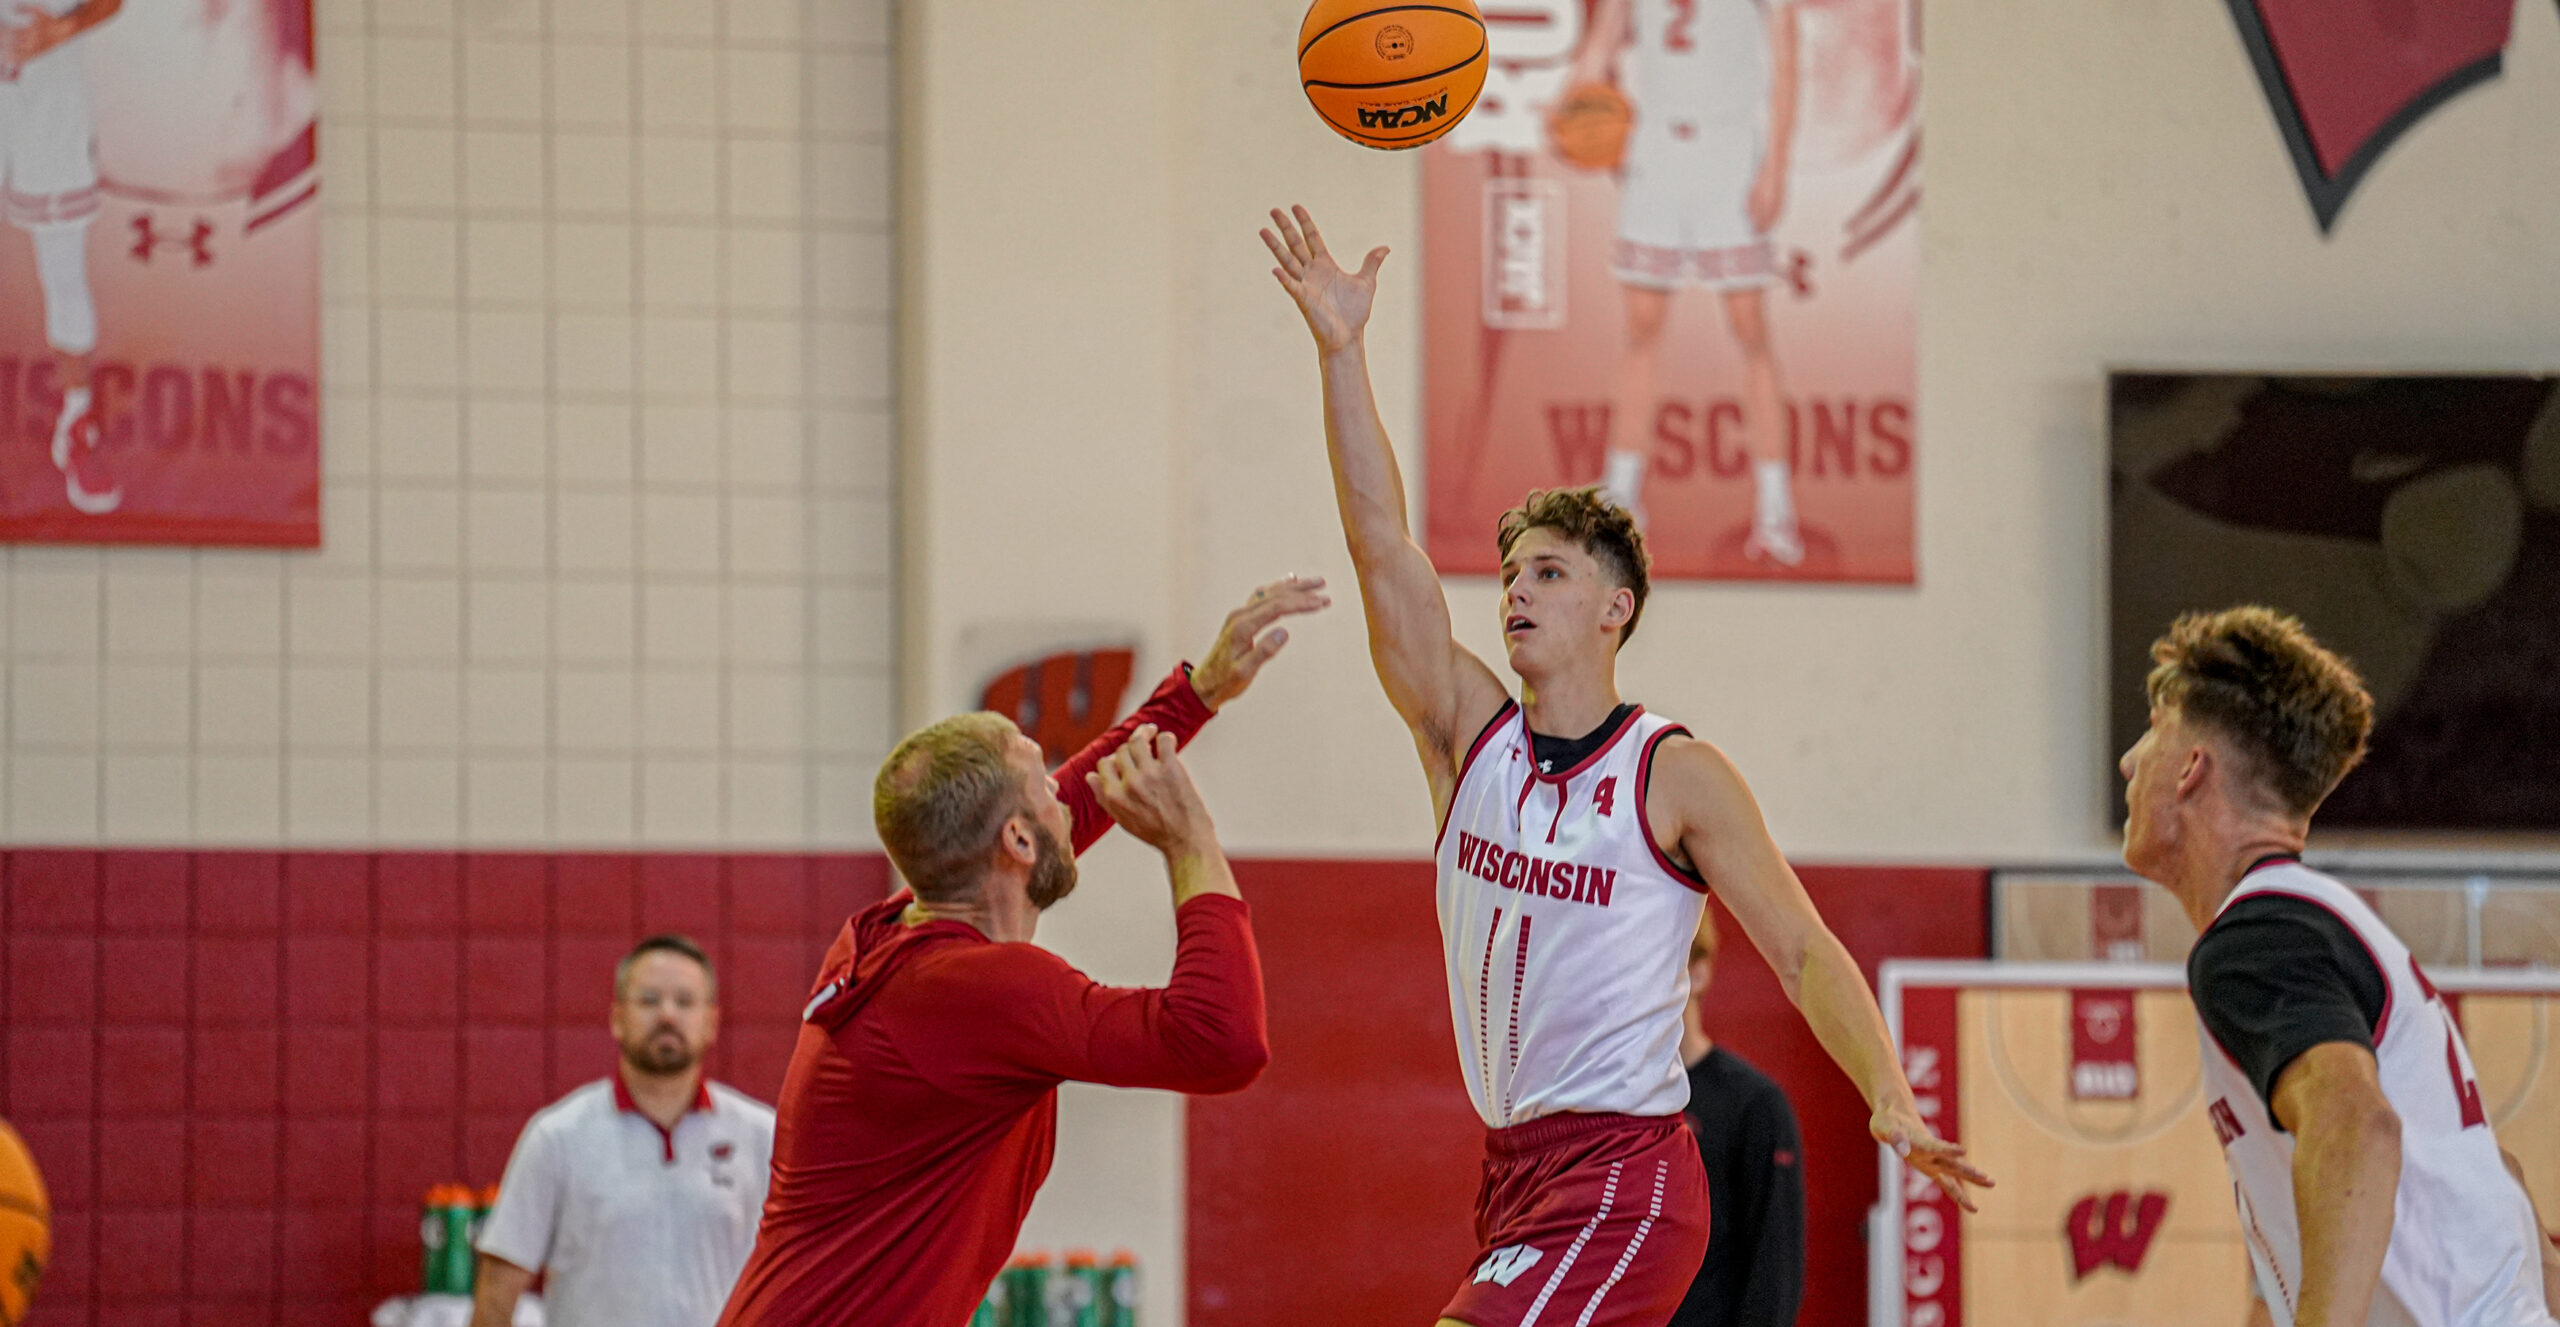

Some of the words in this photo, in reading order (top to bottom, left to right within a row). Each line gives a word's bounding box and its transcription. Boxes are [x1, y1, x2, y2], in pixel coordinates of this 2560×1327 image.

[1357, 93, 1448, 129] NCAA
[1546, 401, 1912, 479] WSCNS
[1592, 774, 1618, 818] 4
[2065, 1188, 2170, 1282] W
[1472, 1243, 1544, 1288] W
